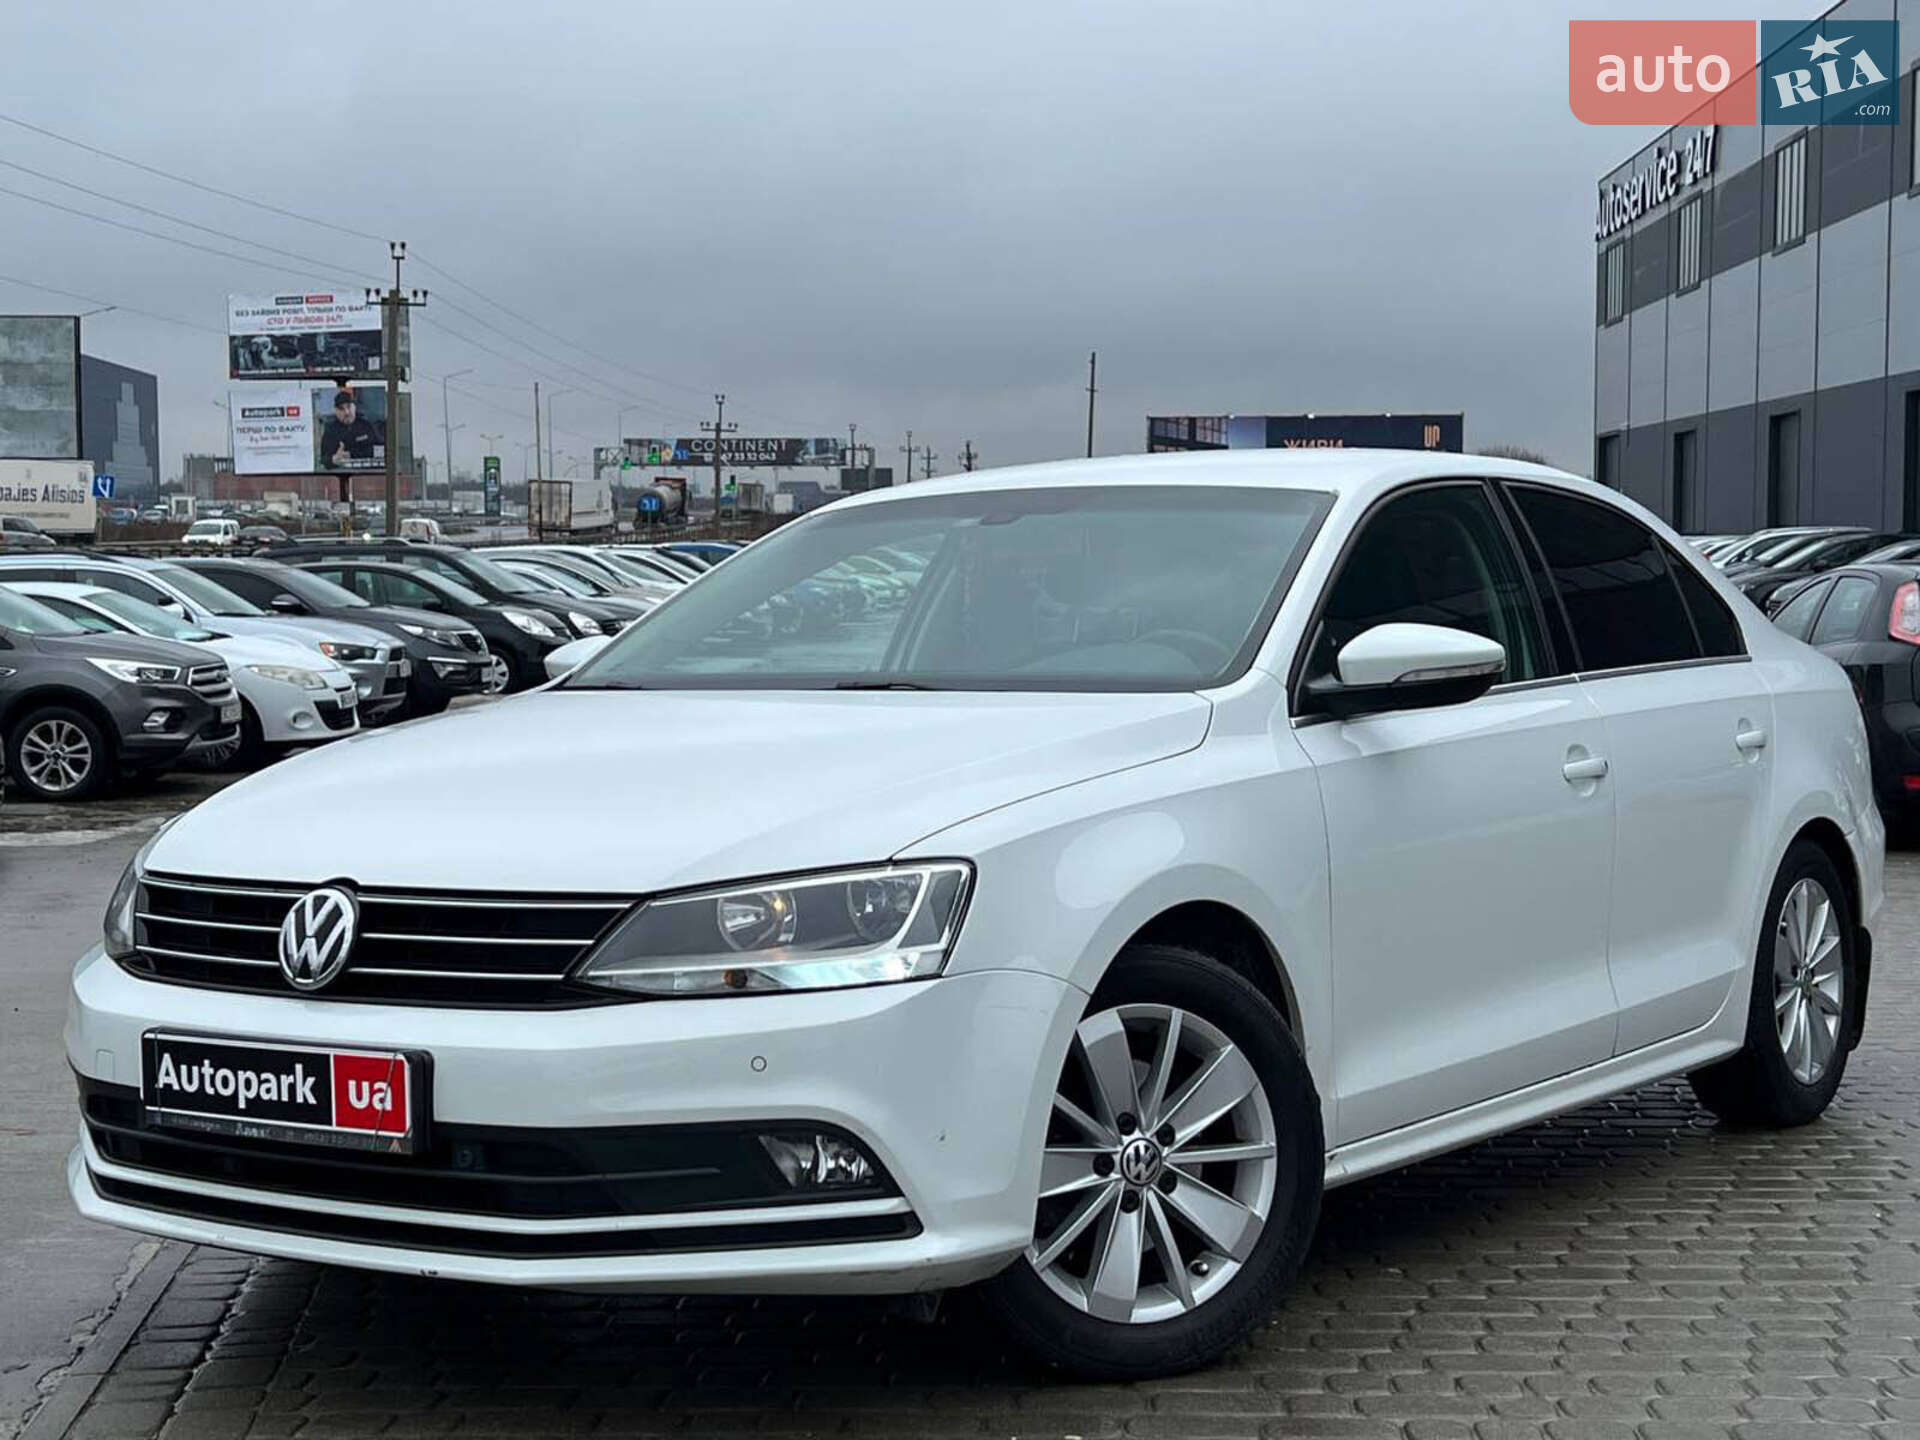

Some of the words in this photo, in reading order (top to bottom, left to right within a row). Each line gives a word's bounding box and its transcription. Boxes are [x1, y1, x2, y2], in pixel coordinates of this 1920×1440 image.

[1596, 147, 1678, 239] Autoservice
[1685, 124, 1716, 185] 24/7
[691, 440, 788, 452] CONTINENT
[157, 1053, 317, 1109] Autopark
[347, 1080, 393, 1112] ua
